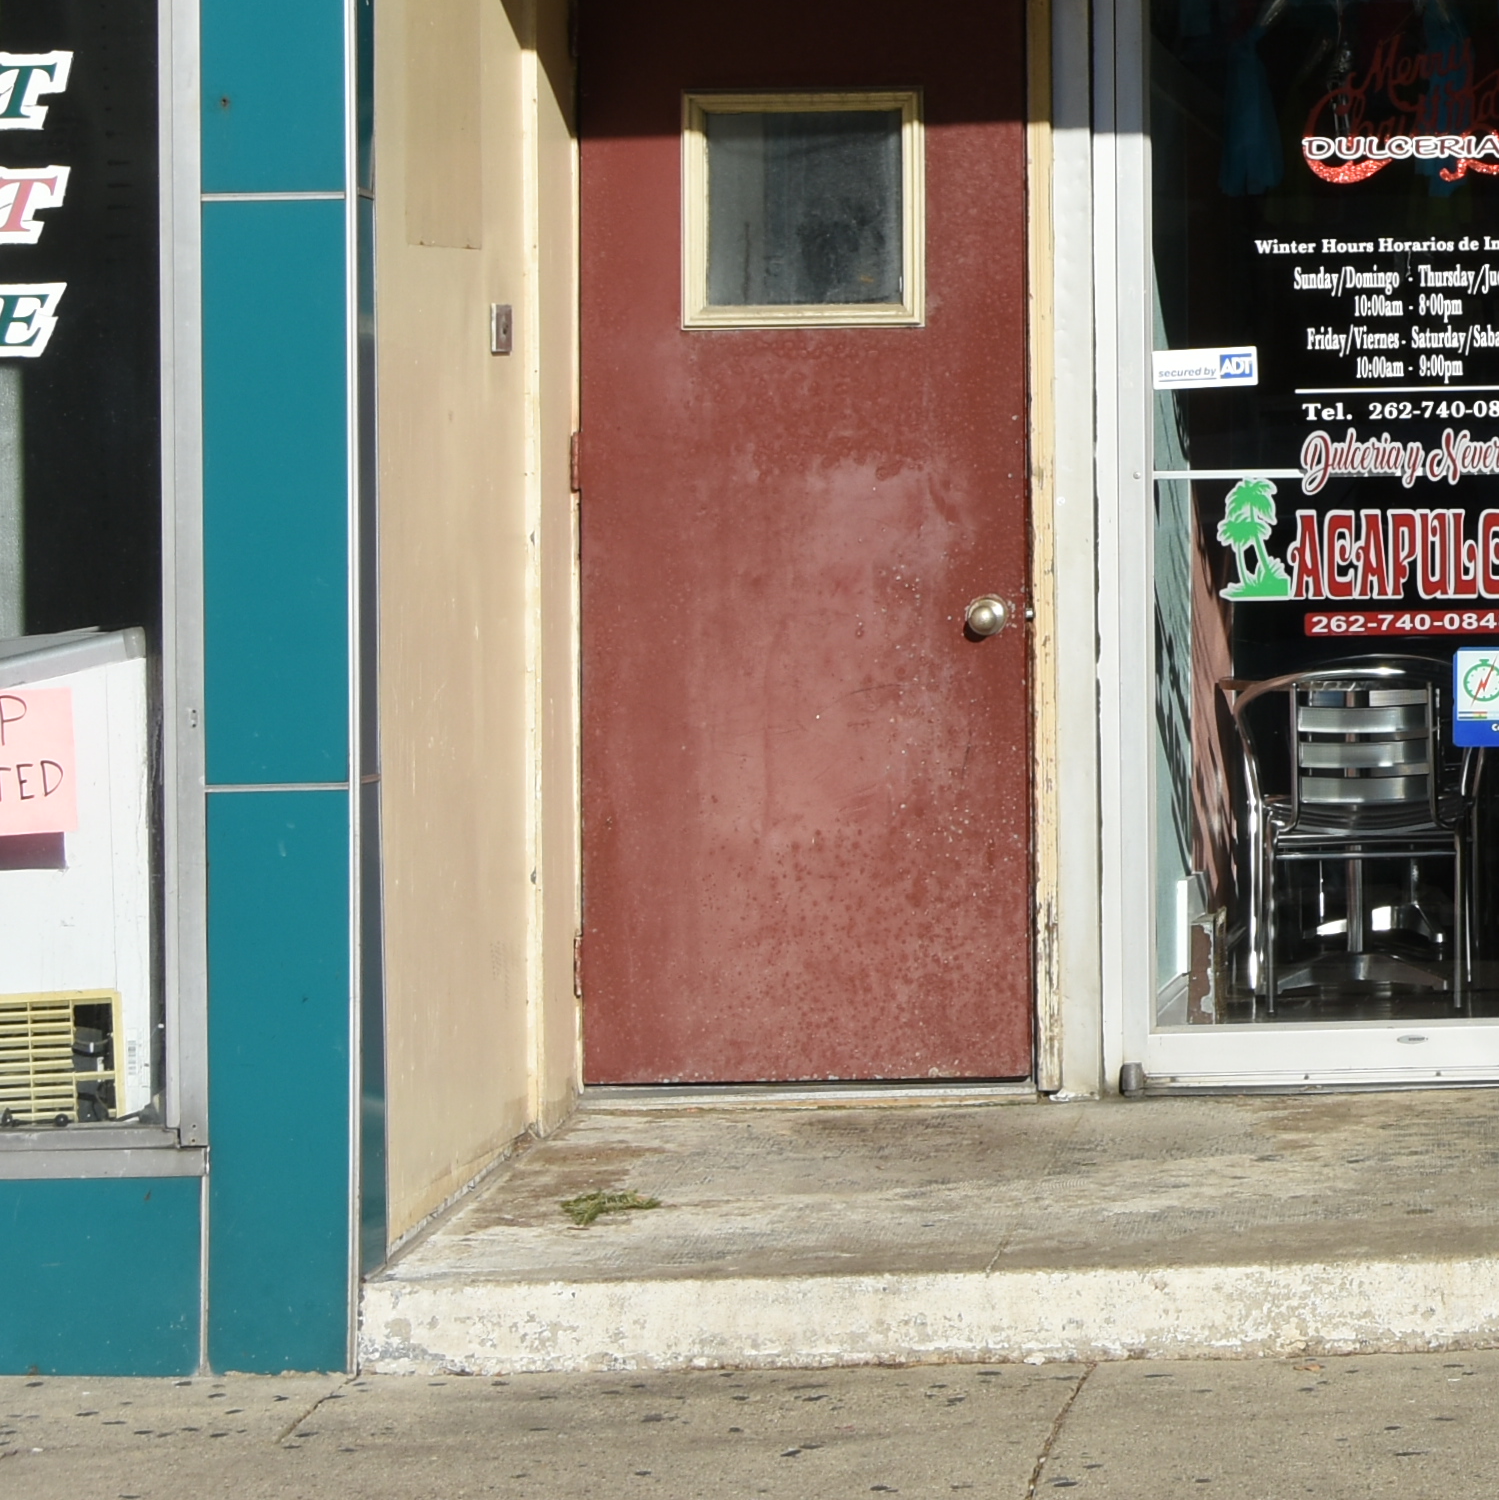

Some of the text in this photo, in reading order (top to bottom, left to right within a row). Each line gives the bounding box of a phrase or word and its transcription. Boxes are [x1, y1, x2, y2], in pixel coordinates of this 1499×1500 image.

[1254, 239, 1316, 254] Winter
[1321, 239, 1374, 253] Hours
[1378, 237, 1454, 252] Horarios
[1458, 237, 1479, 251] de
[1294, 264, 1400, 298] Sunday/Domingo
[1354, 295, 1404, 317] 10:00am
[1307, 324, 1400, 358] Friday/Viernes
[1158, 357, 1253, 378] secured by ADT
[1356, 355, 1463, 384] 10:00am 9:00pm
[1302, 403, 1353, 420] Tel.
[1301, 427, 1404, 495] Dulceria
[1399, 444, 1425, 488] y
